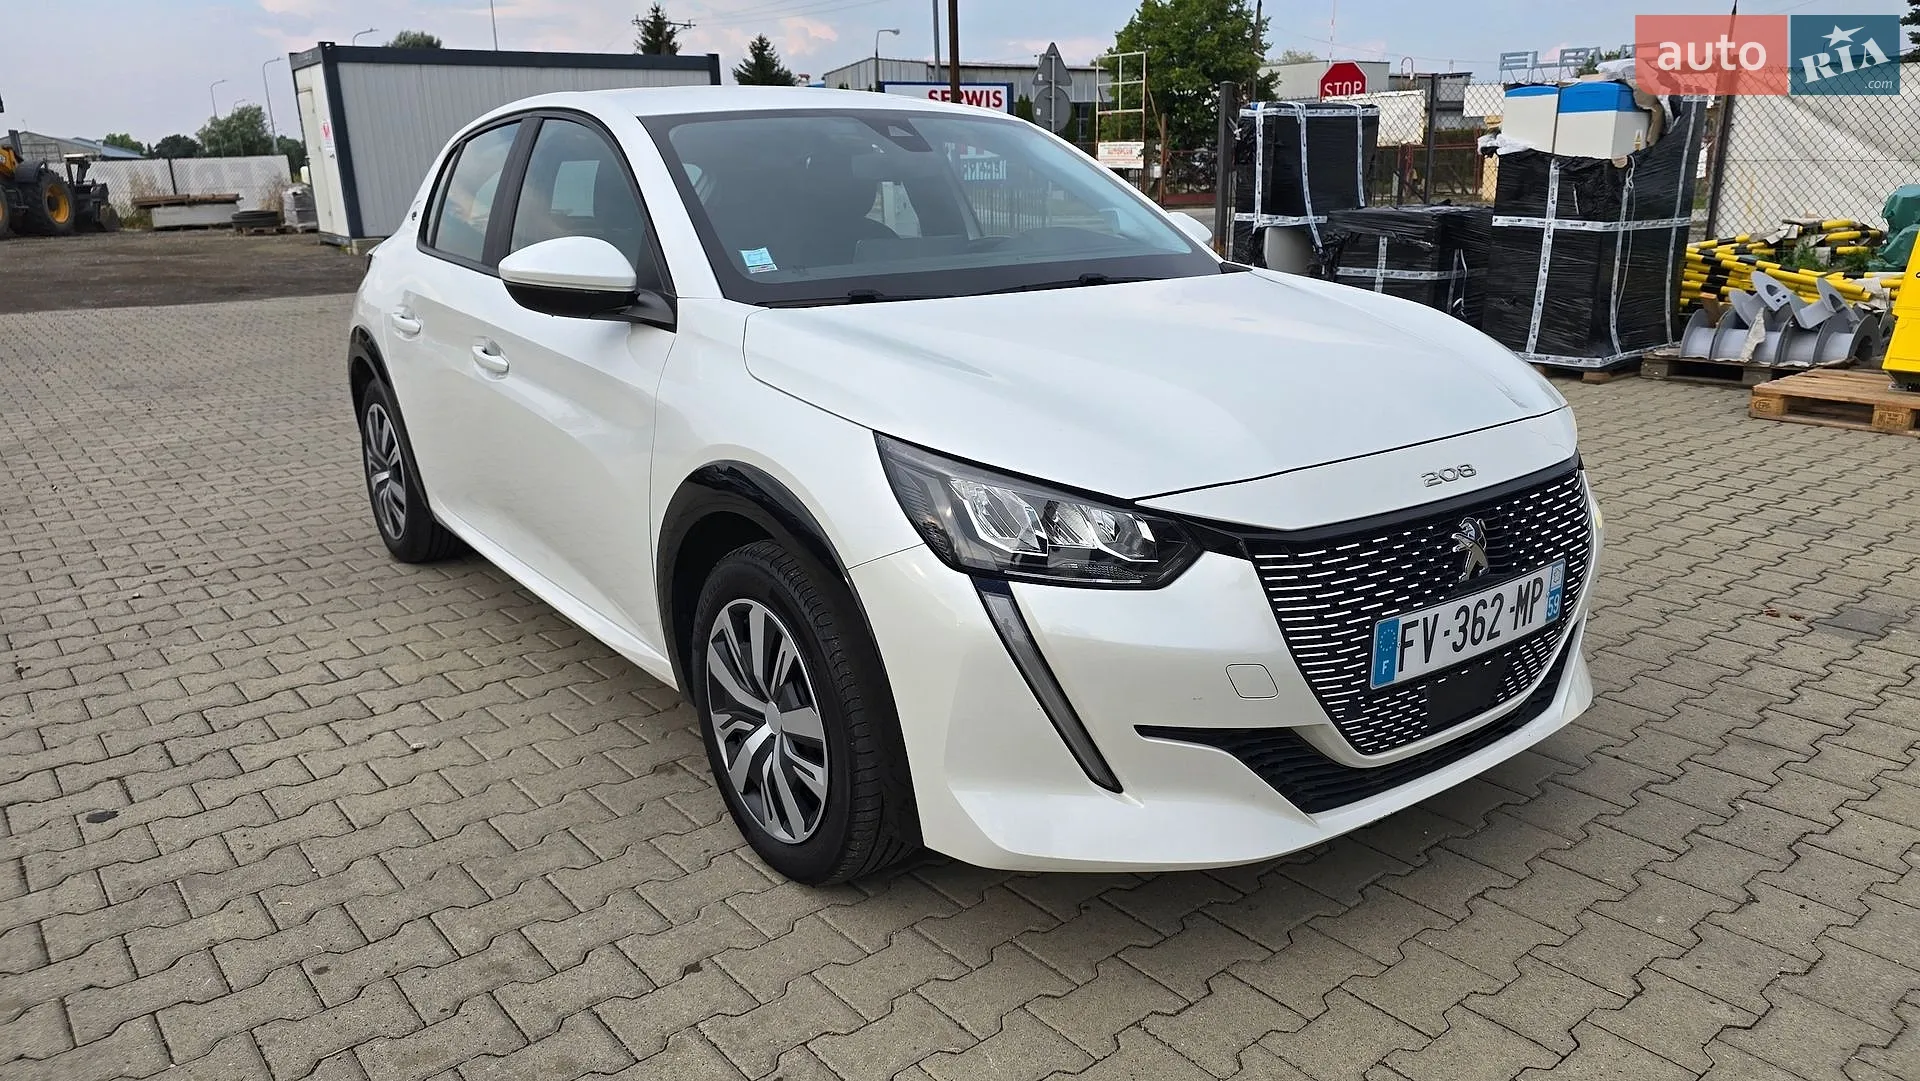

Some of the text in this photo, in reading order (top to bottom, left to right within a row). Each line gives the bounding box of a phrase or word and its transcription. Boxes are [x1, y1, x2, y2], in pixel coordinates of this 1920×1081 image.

[928, 89, 1003, 108] SEWIS
[1324, 81, 1362, 97] STOP
[1421, 464, 1476, 488] 208
[1547, 593, 1560, 617] 59
[1382, 659, 1390, 675] F
